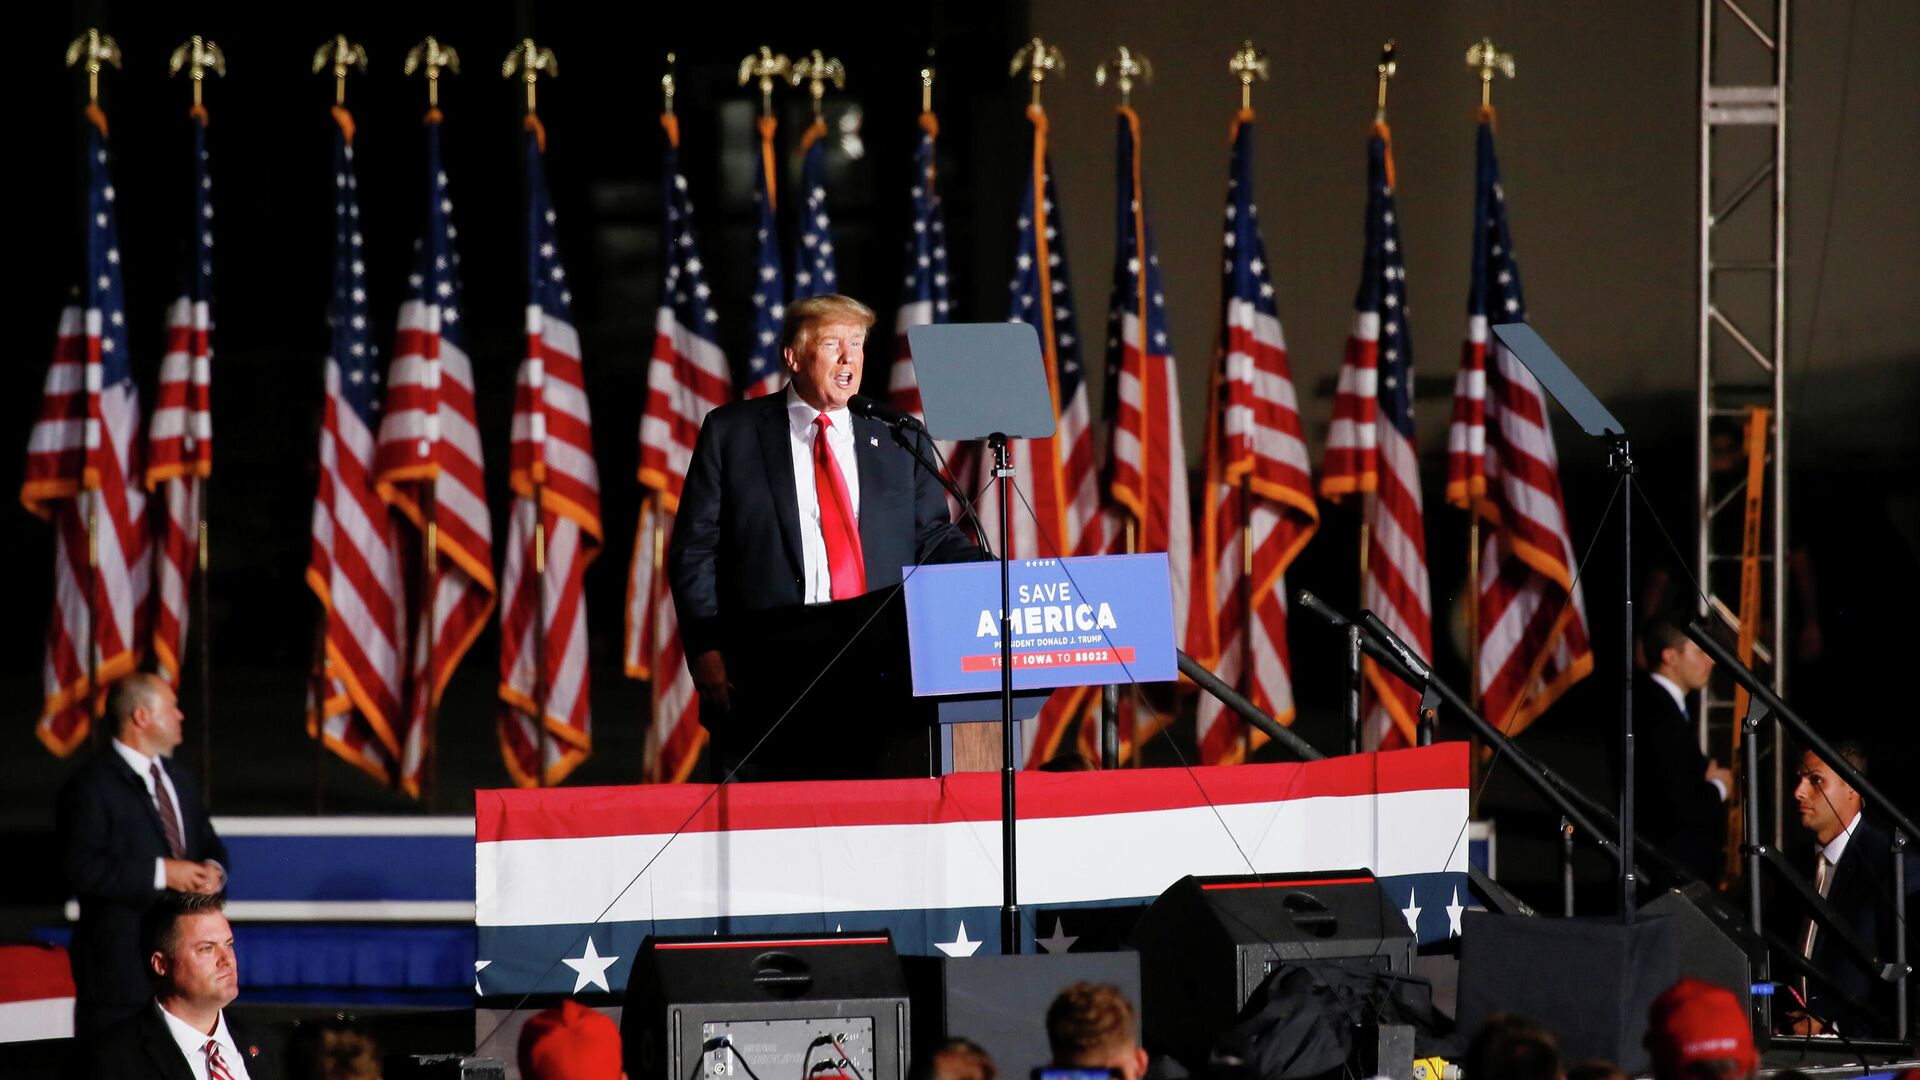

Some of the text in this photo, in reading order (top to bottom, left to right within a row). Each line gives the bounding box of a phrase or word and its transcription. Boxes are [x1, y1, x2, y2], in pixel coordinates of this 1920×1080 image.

[1019, 582, 1071, 604] SAVE
[976, 602, 1118, 637] AMERICA
[994, 634, 1102, 649] PIDENT DONALD J. TRUMP
[991, 651, 1108, 667] TET IOWA TO 88022
